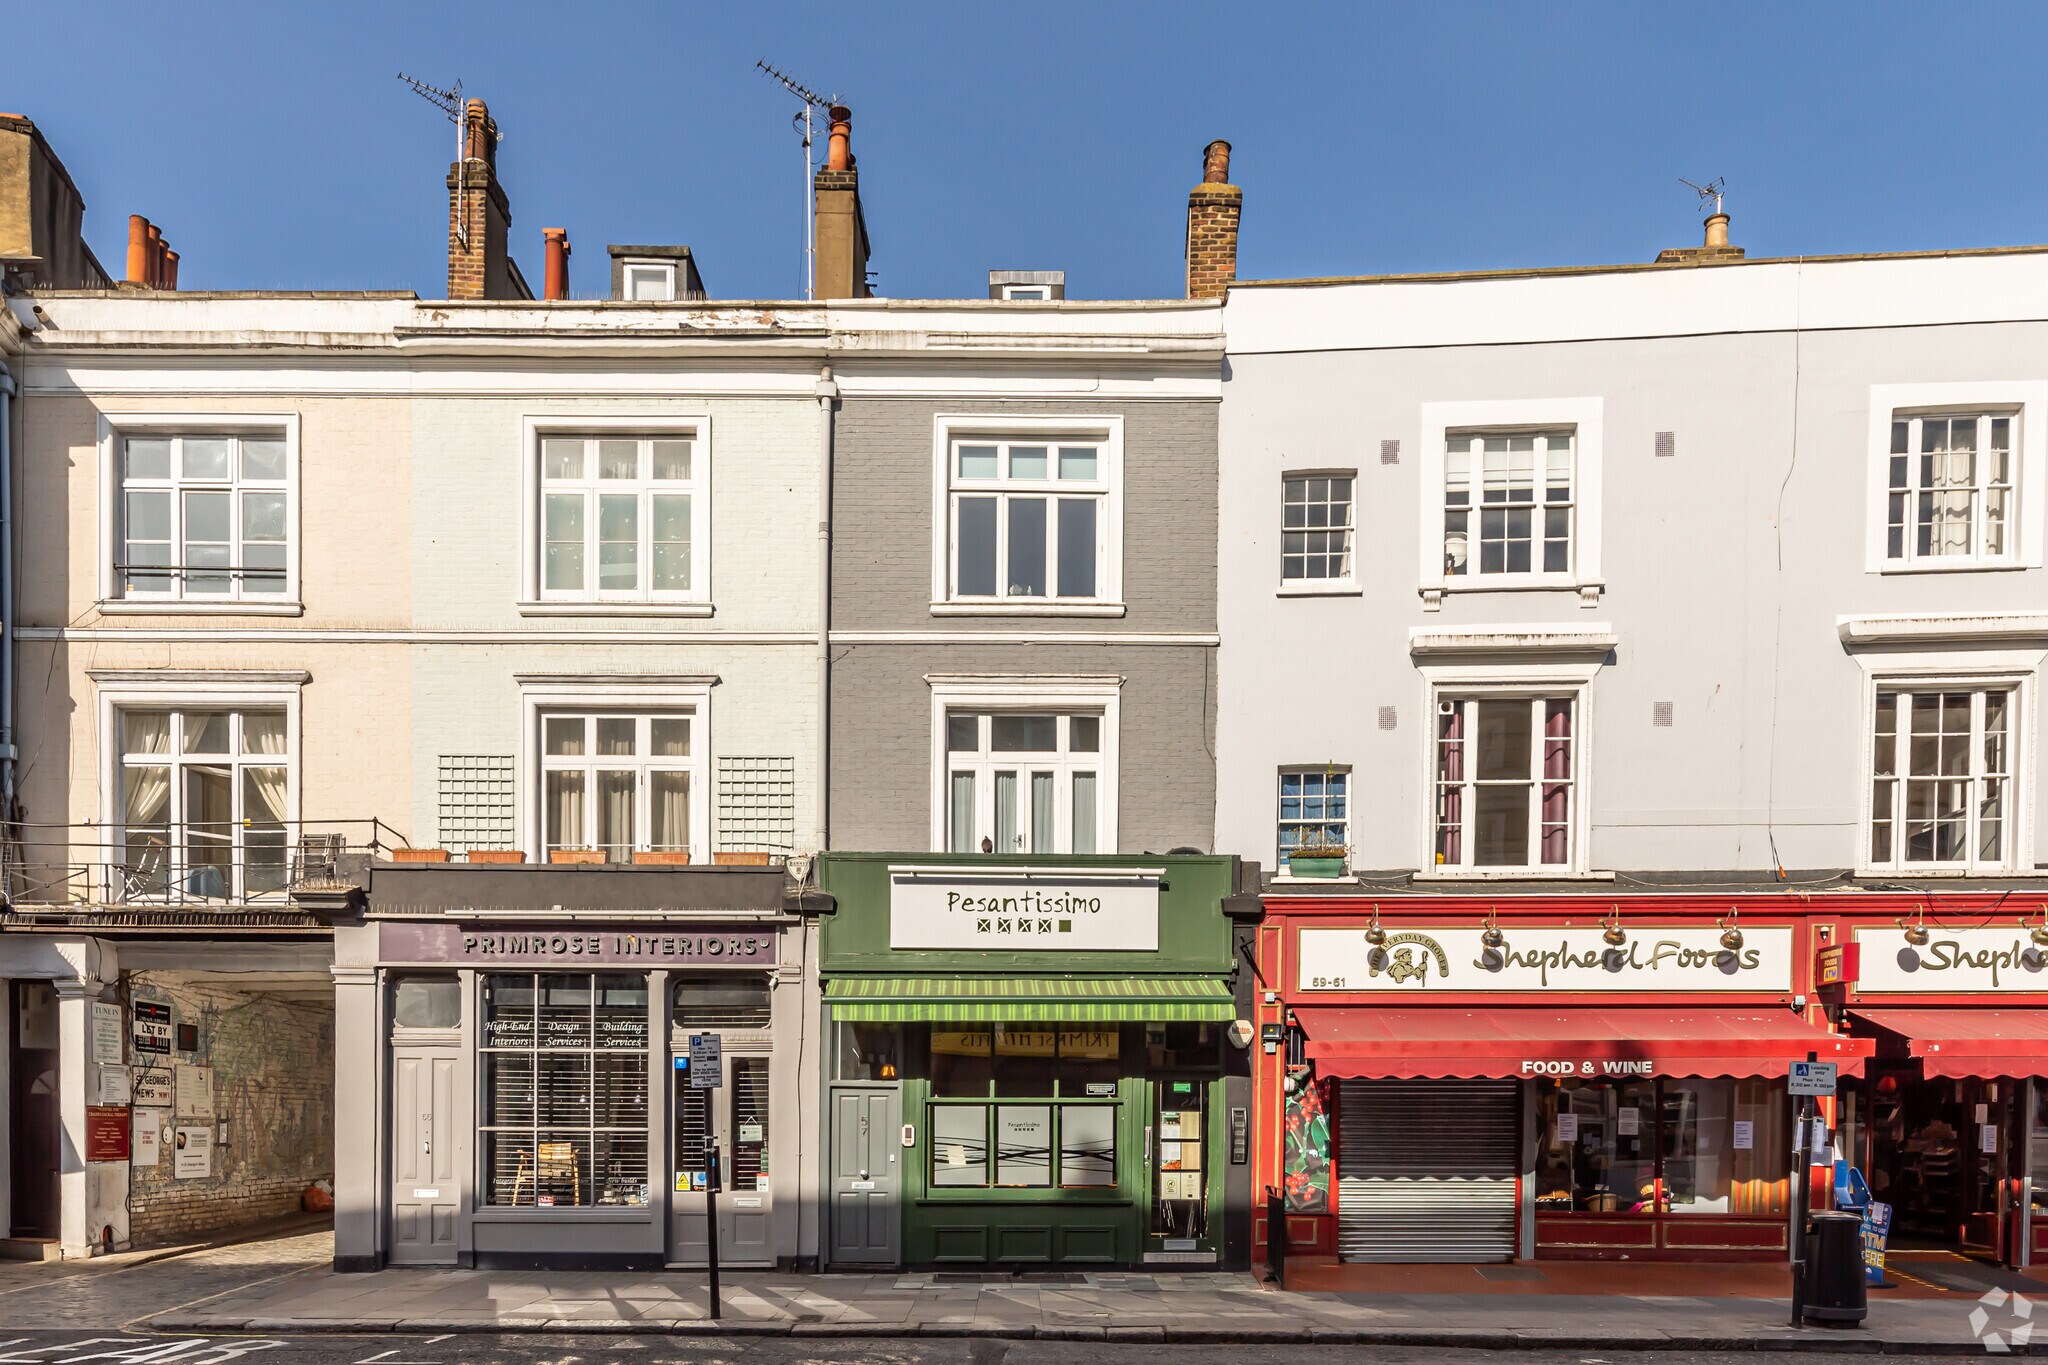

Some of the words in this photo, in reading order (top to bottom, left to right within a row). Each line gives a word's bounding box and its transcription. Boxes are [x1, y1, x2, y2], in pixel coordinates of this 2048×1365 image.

[947, 891, 1101, 914] Pesantissimo
[463, 935, 600, 955] PRIMROSE
[1425, 939, 1447, 971] GROCER
[1473, 940, 1643, 986] Shepherd
[1645, 940, 1760, 970] Foods
[1825, 969, 1836, 978] ATM
[1312, 977, 1346, 988] 59-61
[95, 1006, 112, 1015] TUNE
[142, 1024, 156, 1034] LET
[157, 1026, 168, 1036] BY
[484, 1021, 531, 1032] High-End
[548, 1021, 580, 1033] Design
[603, 1021, 643, 1033] Building
[490, 1037, 529, 1047] Interiors
[546, 1037, 583, 1047] Services
[604, 1037, 642, 1047] Services
[1521, 1061, 1575, 1074] FOOD
[1581, 1061, 1595, 1074] &
[1602, 1061, 1653, 1074] WINE
[145, 1076, 171, 1086] GEORGE'S
[136, 1088, 155, 1099] MEWS
[1878, 1226, 1886, 1235] USE
[1861, 1230, 1886, 1251] ATM
[1865, 1250, 1883, 1267] ERE
